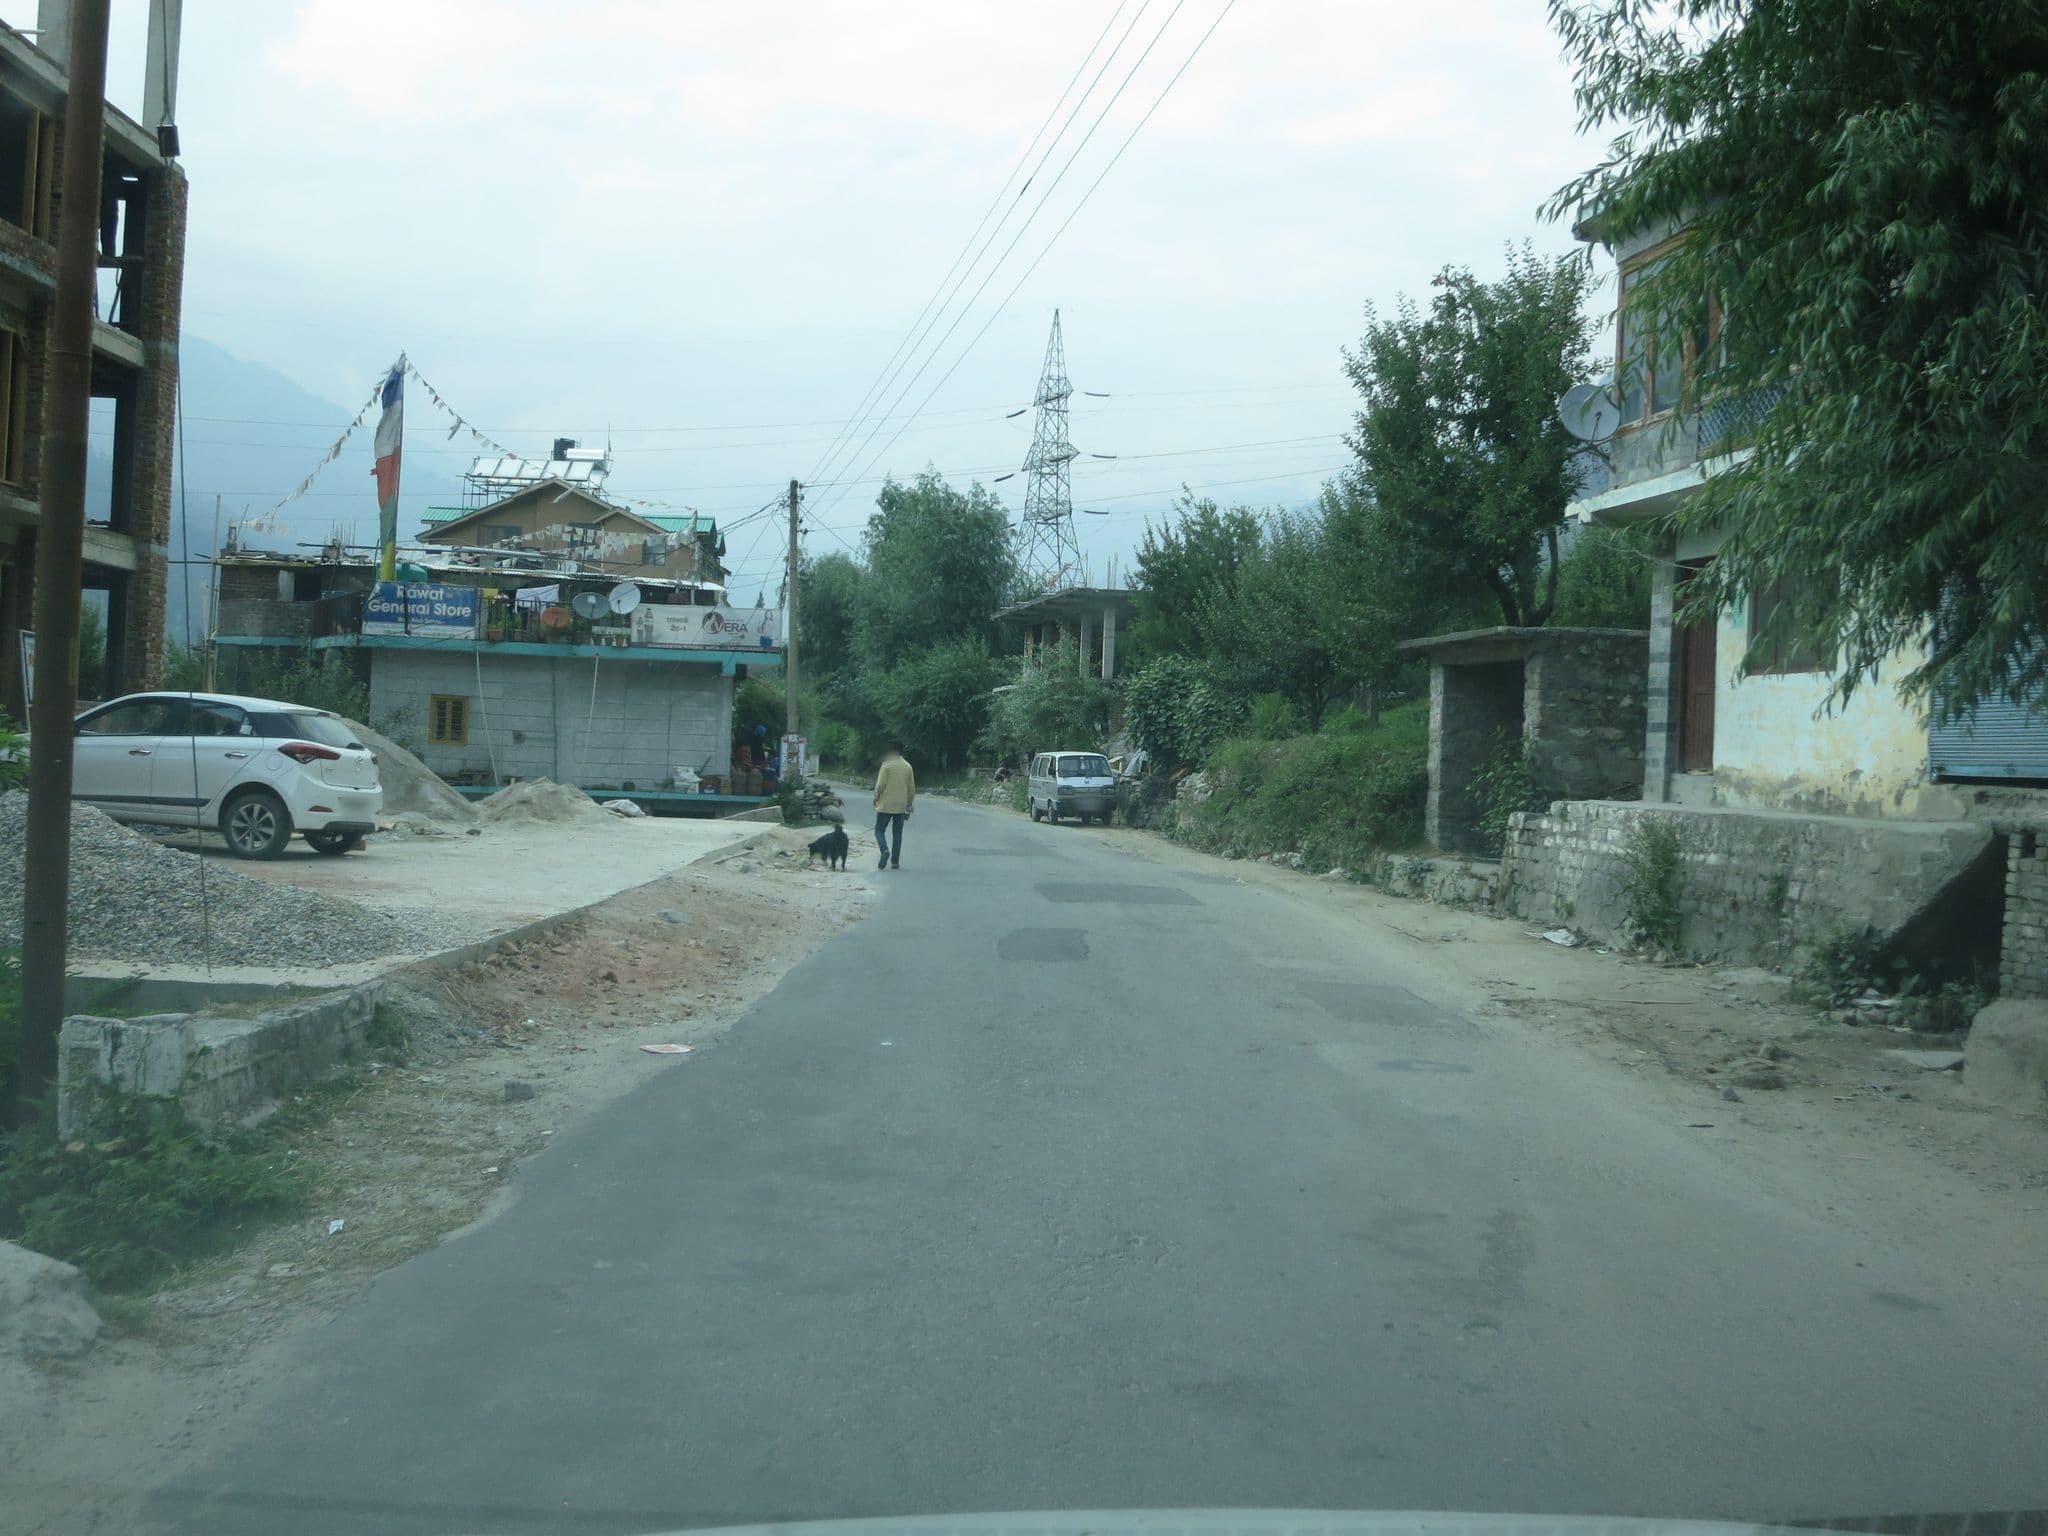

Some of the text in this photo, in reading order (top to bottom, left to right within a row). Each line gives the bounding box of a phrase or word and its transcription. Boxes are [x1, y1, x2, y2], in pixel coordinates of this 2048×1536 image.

[396, 585, 445, 600] Rawat
[369, 600, 471, 617] General Store
